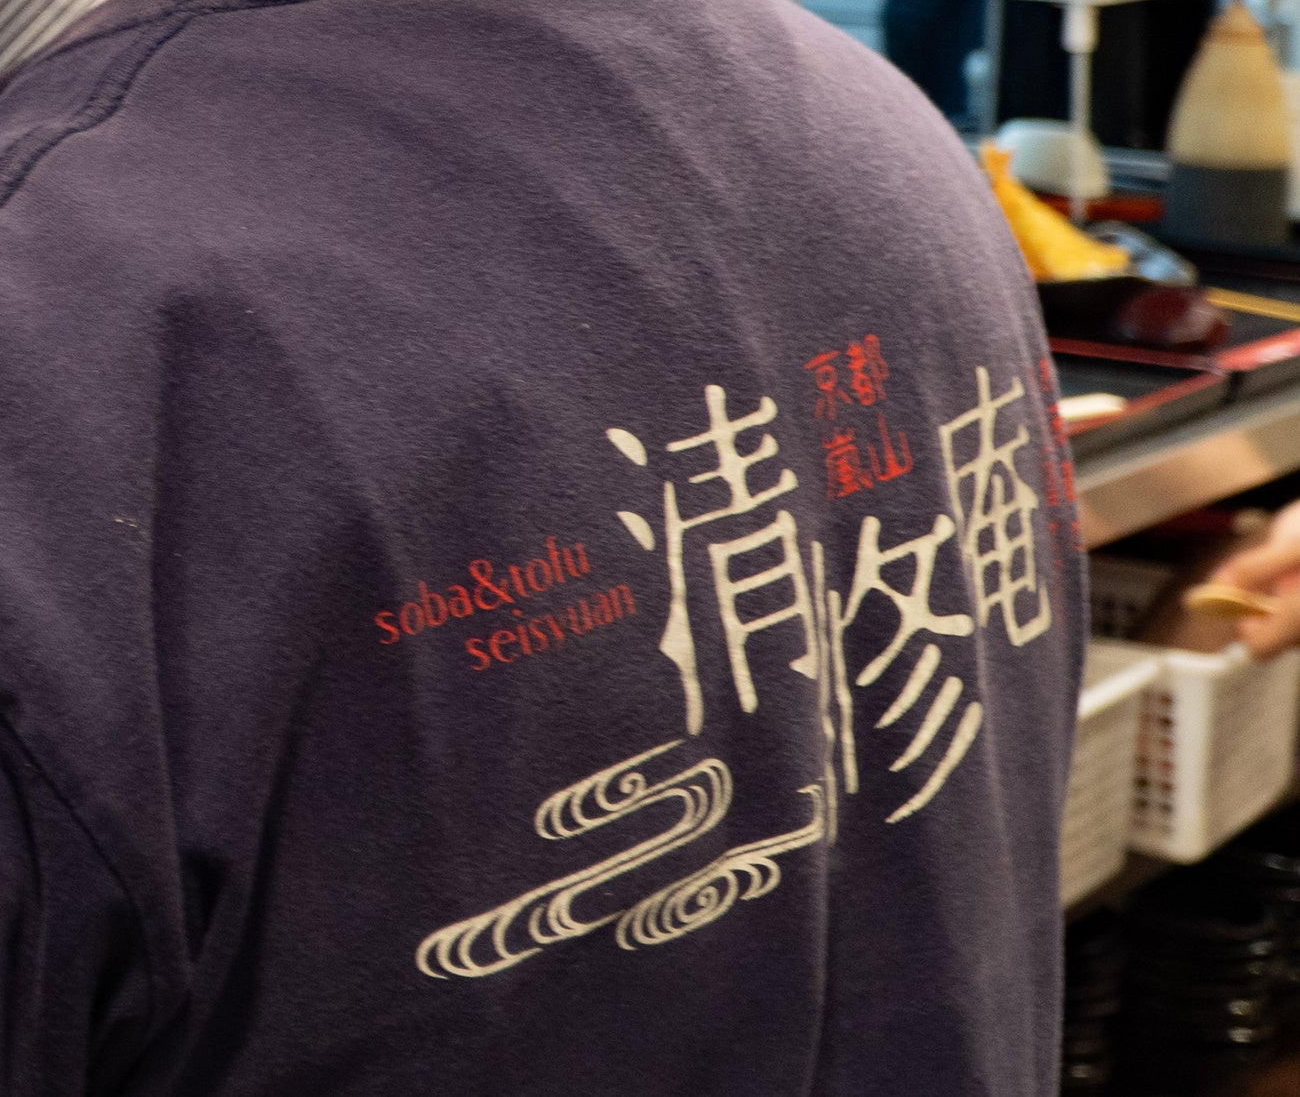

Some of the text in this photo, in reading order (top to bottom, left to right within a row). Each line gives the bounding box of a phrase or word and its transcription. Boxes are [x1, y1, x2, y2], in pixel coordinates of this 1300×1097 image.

[804, 333, 889, 421] 京都
[821, 413, 914, 501] 嵐山
[373, 534, 591, 645] soba&tofu
